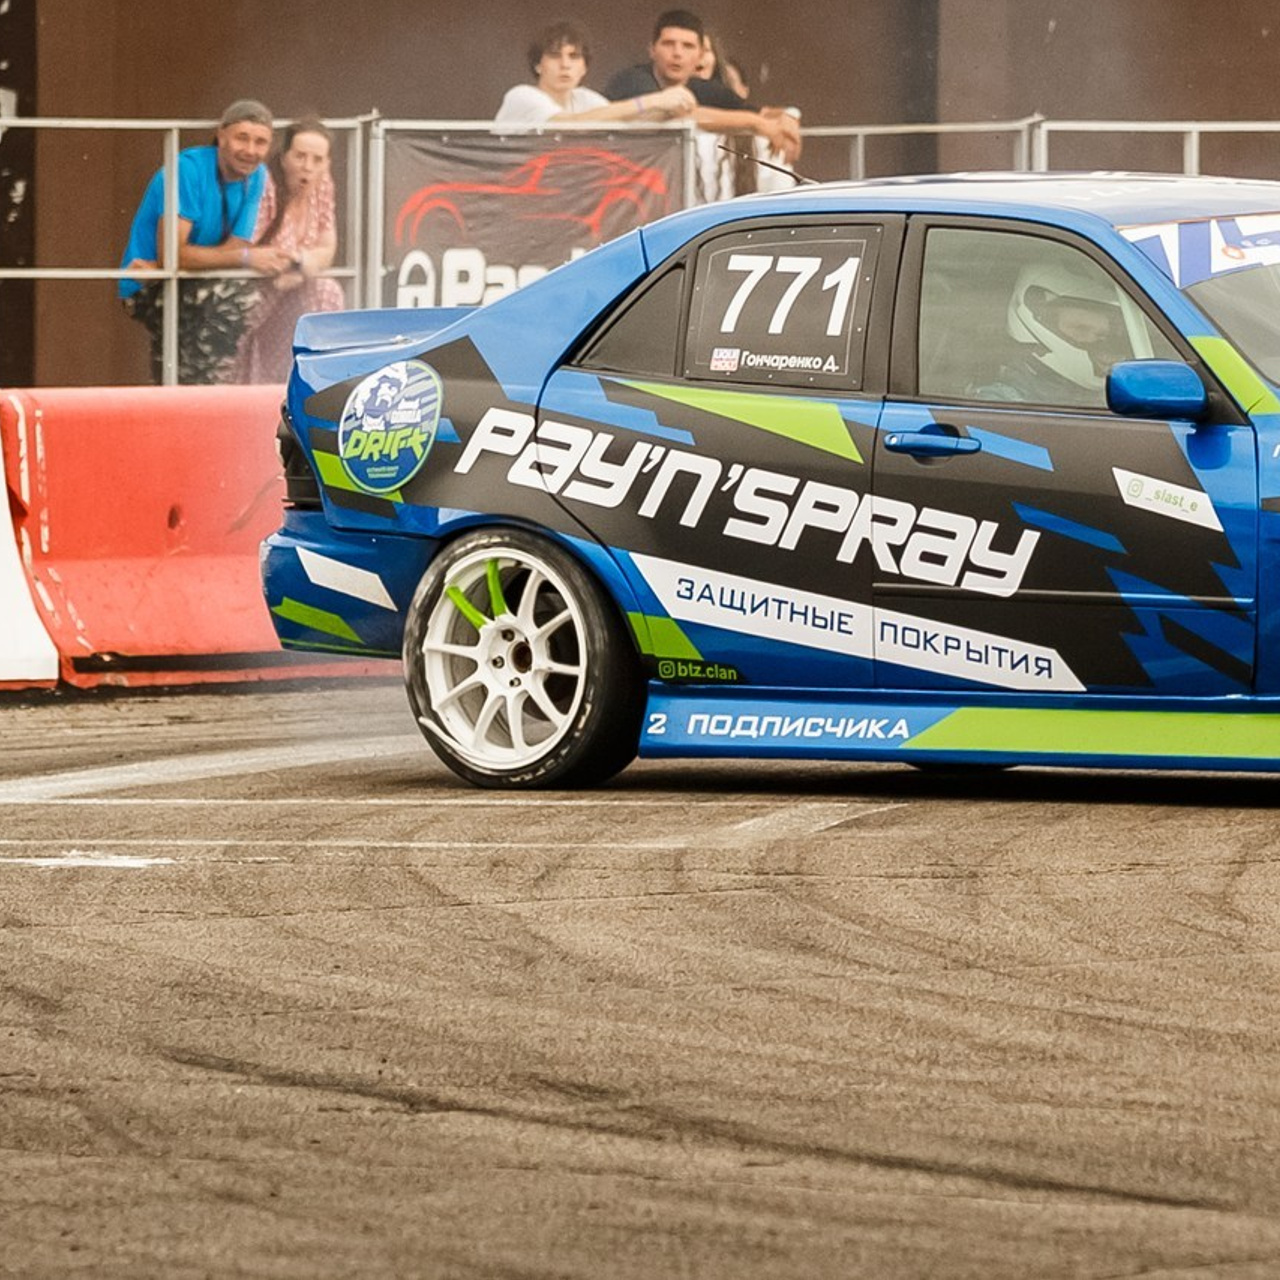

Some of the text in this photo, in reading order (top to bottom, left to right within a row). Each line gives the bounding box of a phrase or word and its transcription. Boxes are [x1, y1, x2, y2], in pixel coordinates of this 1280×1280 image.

[720, 254, 861, 337] 771
[740, 350, 823, 370] Гончаренко
[343, 426, 429, 461] DRIFT
[676, 578, 1054, 680] ЗАЩИТНЫЕ ПОКРЫТИЯ
[677, 661, 737, 680] btz.clan
[647, 713, 910, 739] 2 ПОДПИСЧИКА
